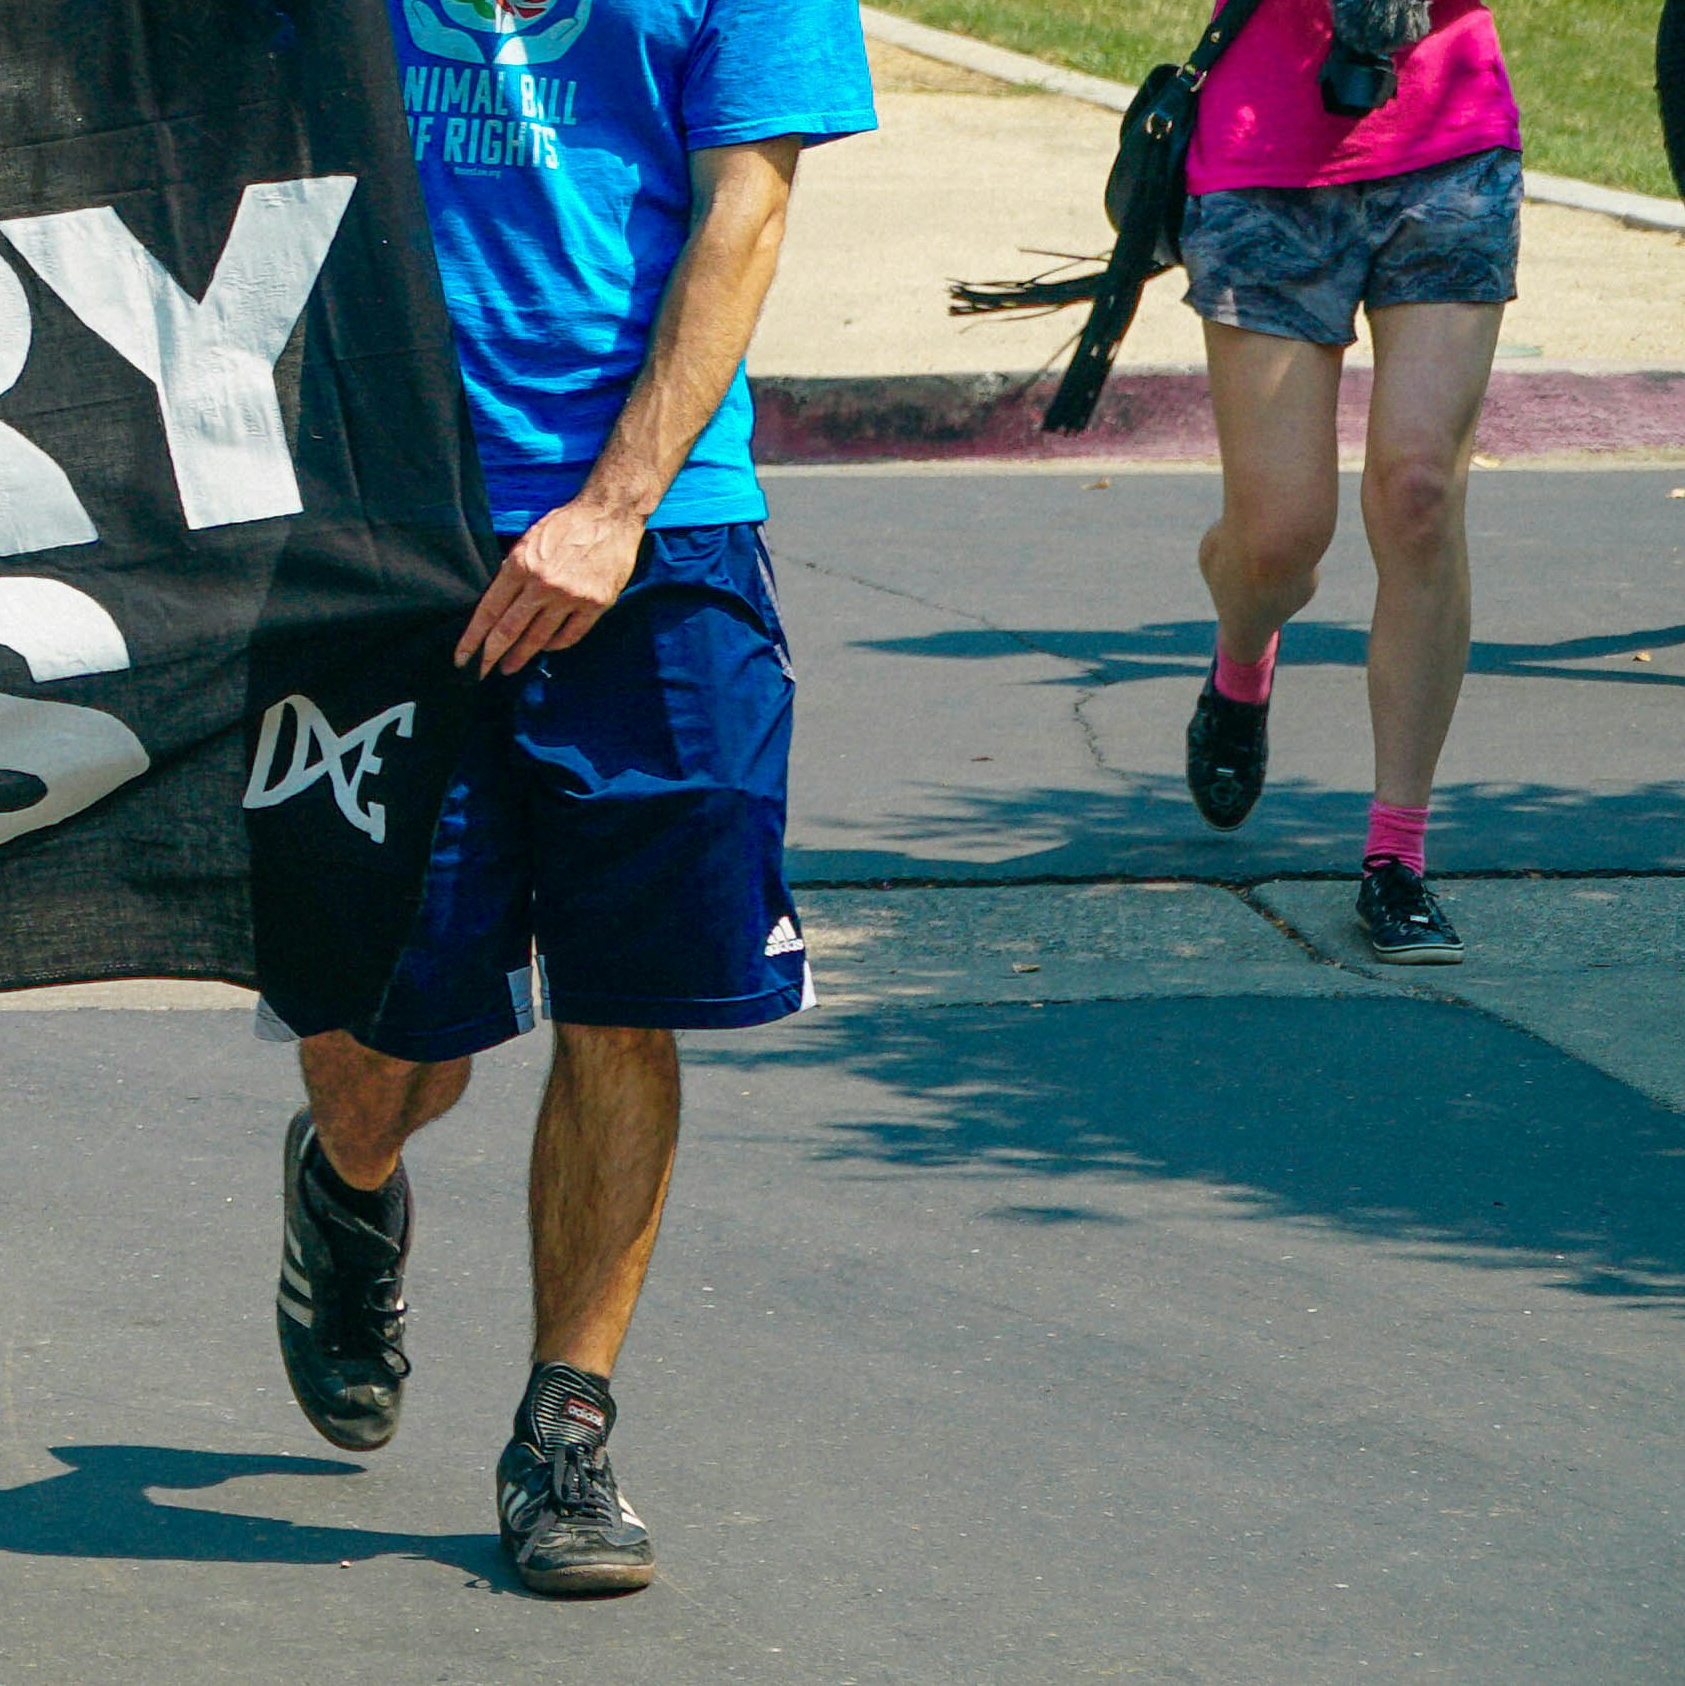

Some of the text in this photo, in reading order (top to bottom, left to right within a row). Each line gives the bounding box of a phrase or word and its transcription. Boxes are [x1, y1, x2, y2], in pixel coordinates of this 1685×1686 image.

[404, 66, 577, 126] NIMAL BILL
[444, 117, 560, 170] RIGHTS
